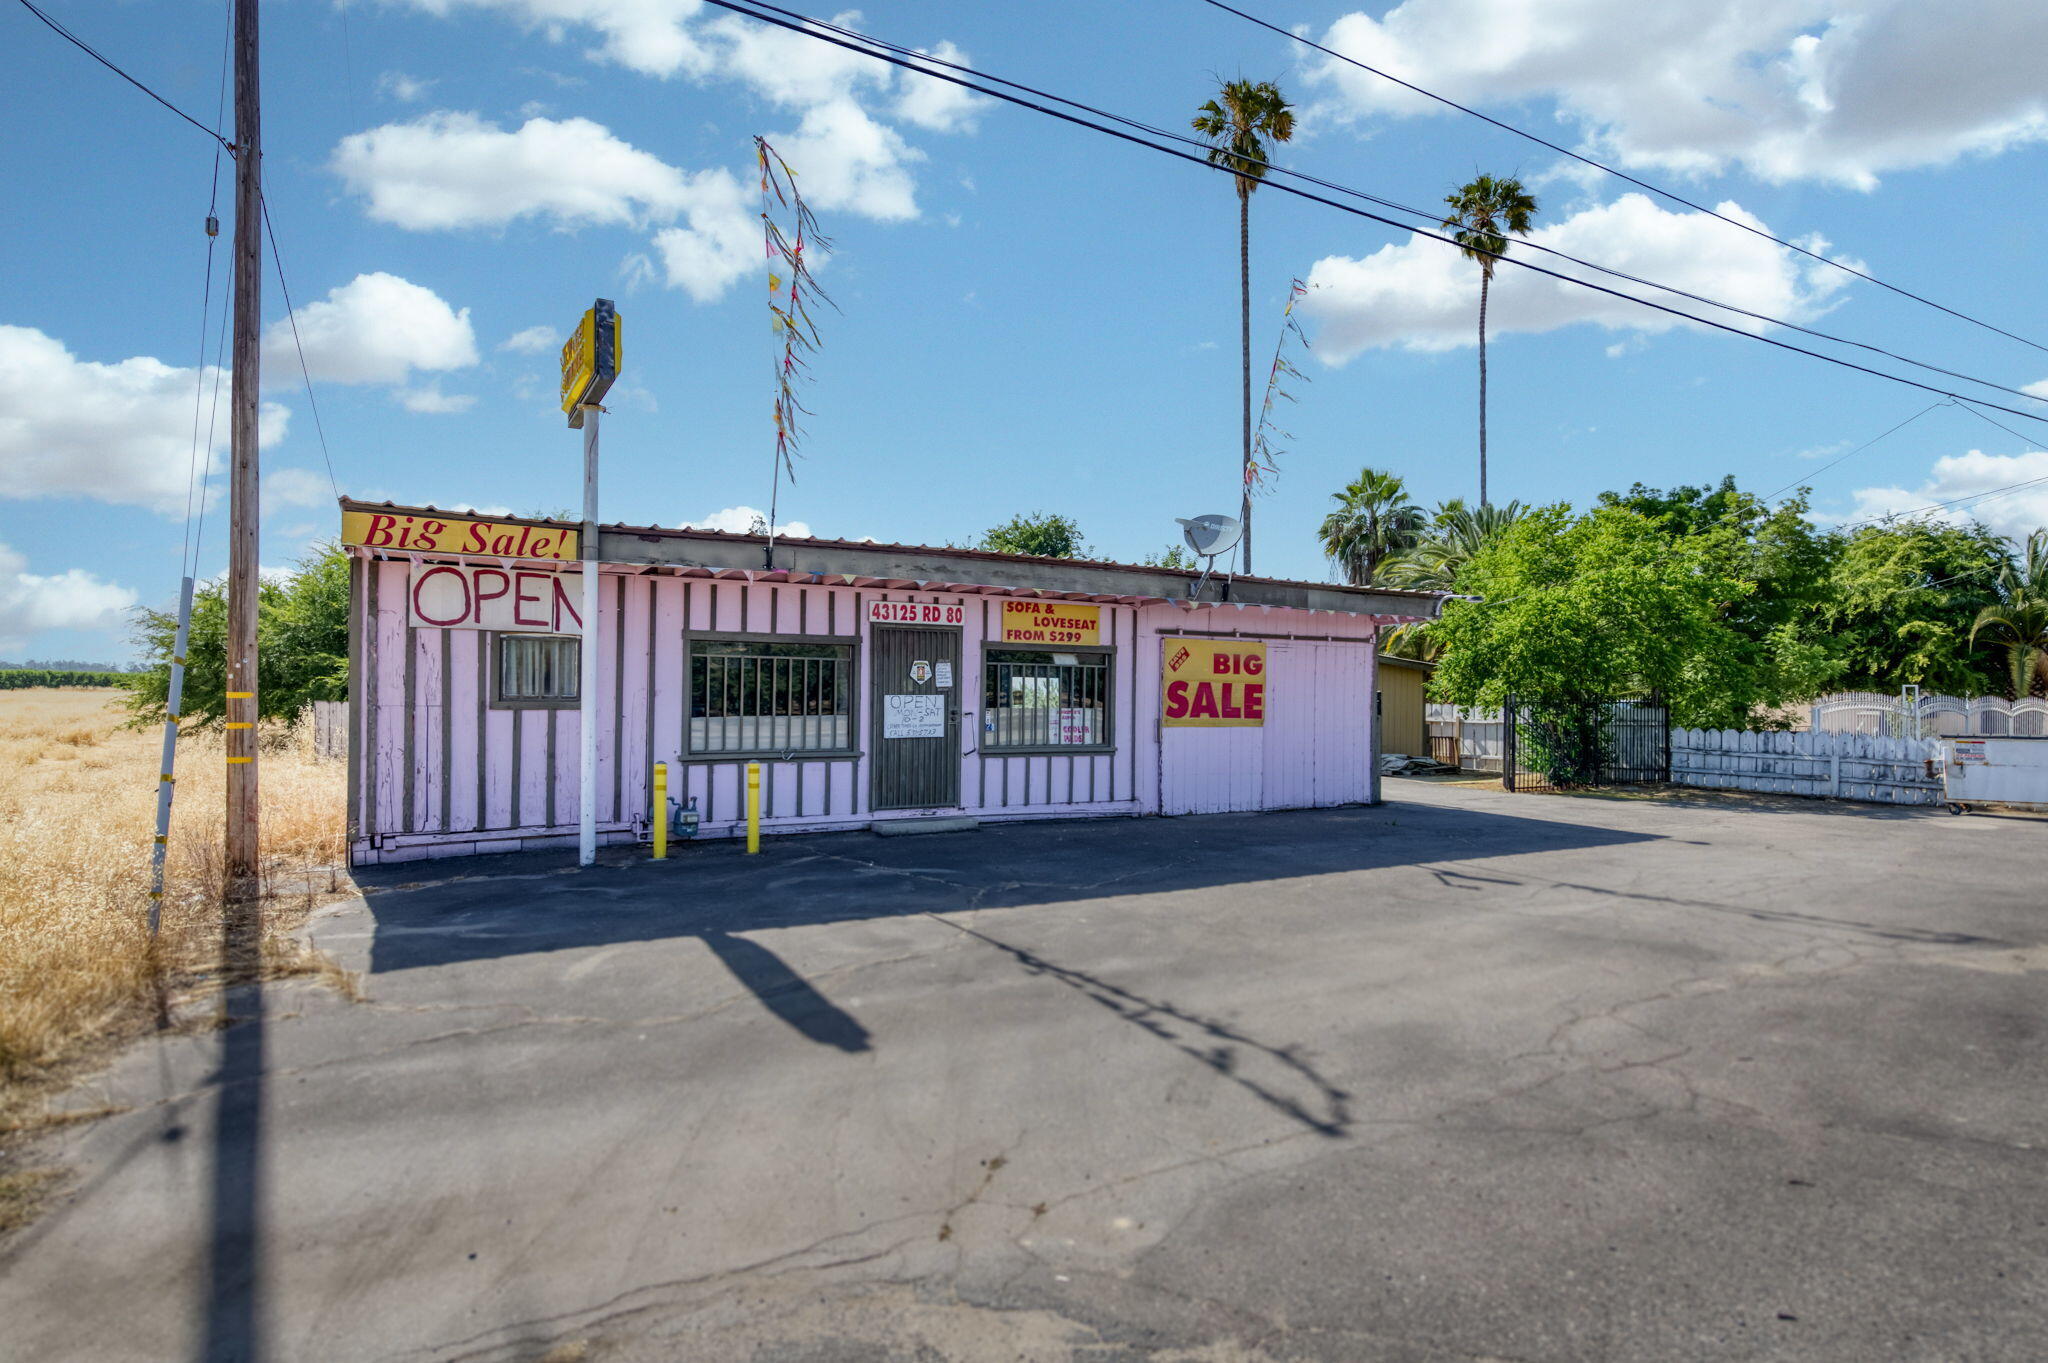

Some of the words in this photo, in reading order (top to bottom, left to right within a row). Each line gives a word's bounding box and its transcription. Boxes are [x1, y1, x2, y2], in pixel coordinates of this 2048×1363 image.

[364, 514, 447, 551] Big
[461, 522, 568, 559] Sale!
[413, 566, 583, 632] OPEN
[1007, 601, 1040, 613] SOFA
[1045, 603, 1055, 615] &
[872, 603, 917, 621] 43125
[922, 605, 941, 622] RD
[946, 607, 963, 623] 80
[1034, 616, 1096, 630] LOVESEAT
[1007, 629, 1045, 641] FROM
[1049, 631, 1082, 642] $299
[1213, 653, 1263, 675] BIG
[890, 695, 937, 709] OPEN
[1166, 680, 1263, 719] SALE
